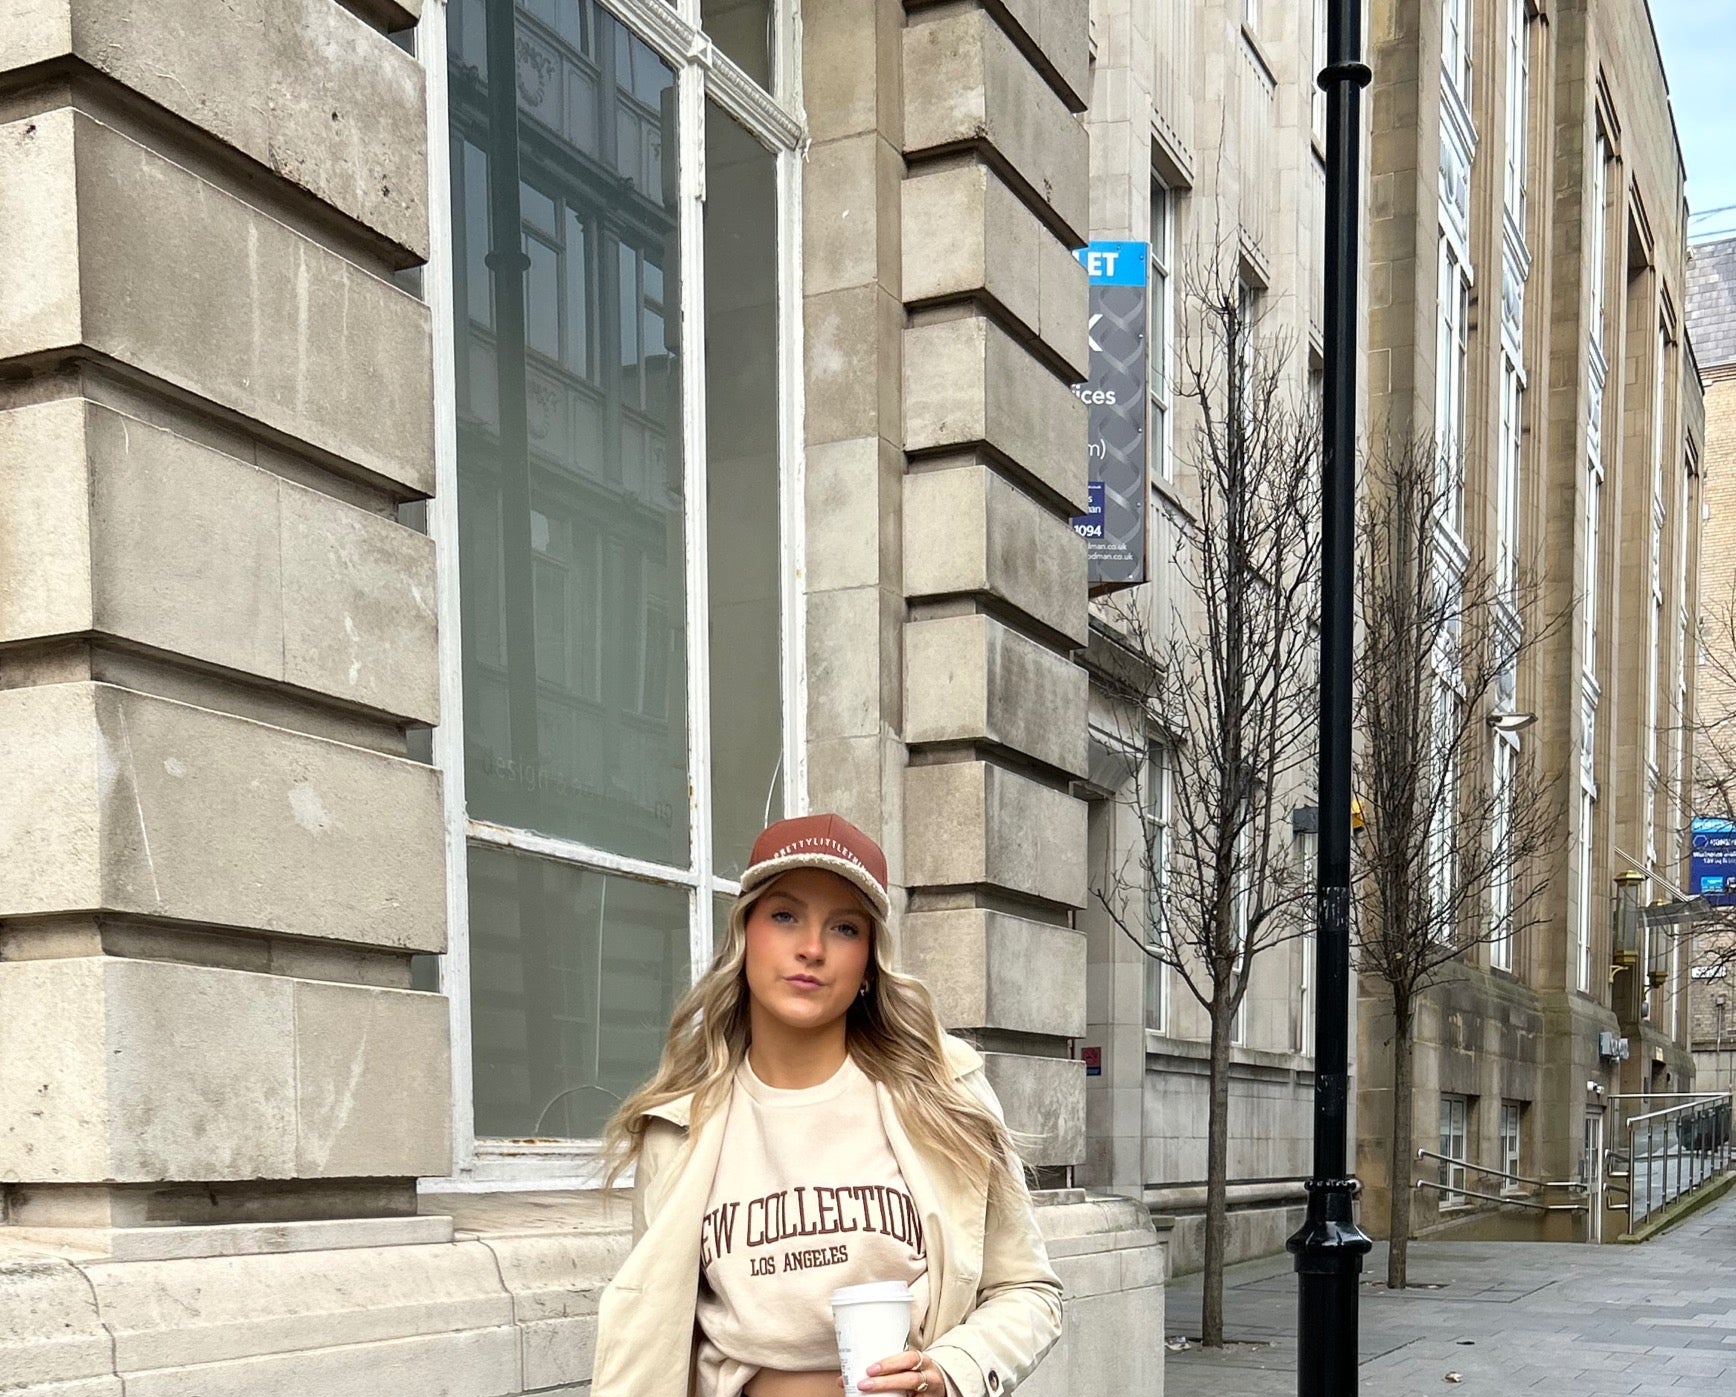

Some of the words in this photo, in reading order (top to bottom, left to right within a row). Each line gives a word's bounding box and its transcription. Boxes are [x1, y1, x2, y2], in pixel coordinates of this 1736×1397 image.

[746, 1185, 924, 1255] COLLECTION
[750, 1256, 776, 1277] LOS
[783, 1245, 849, 1273] ANGELES
